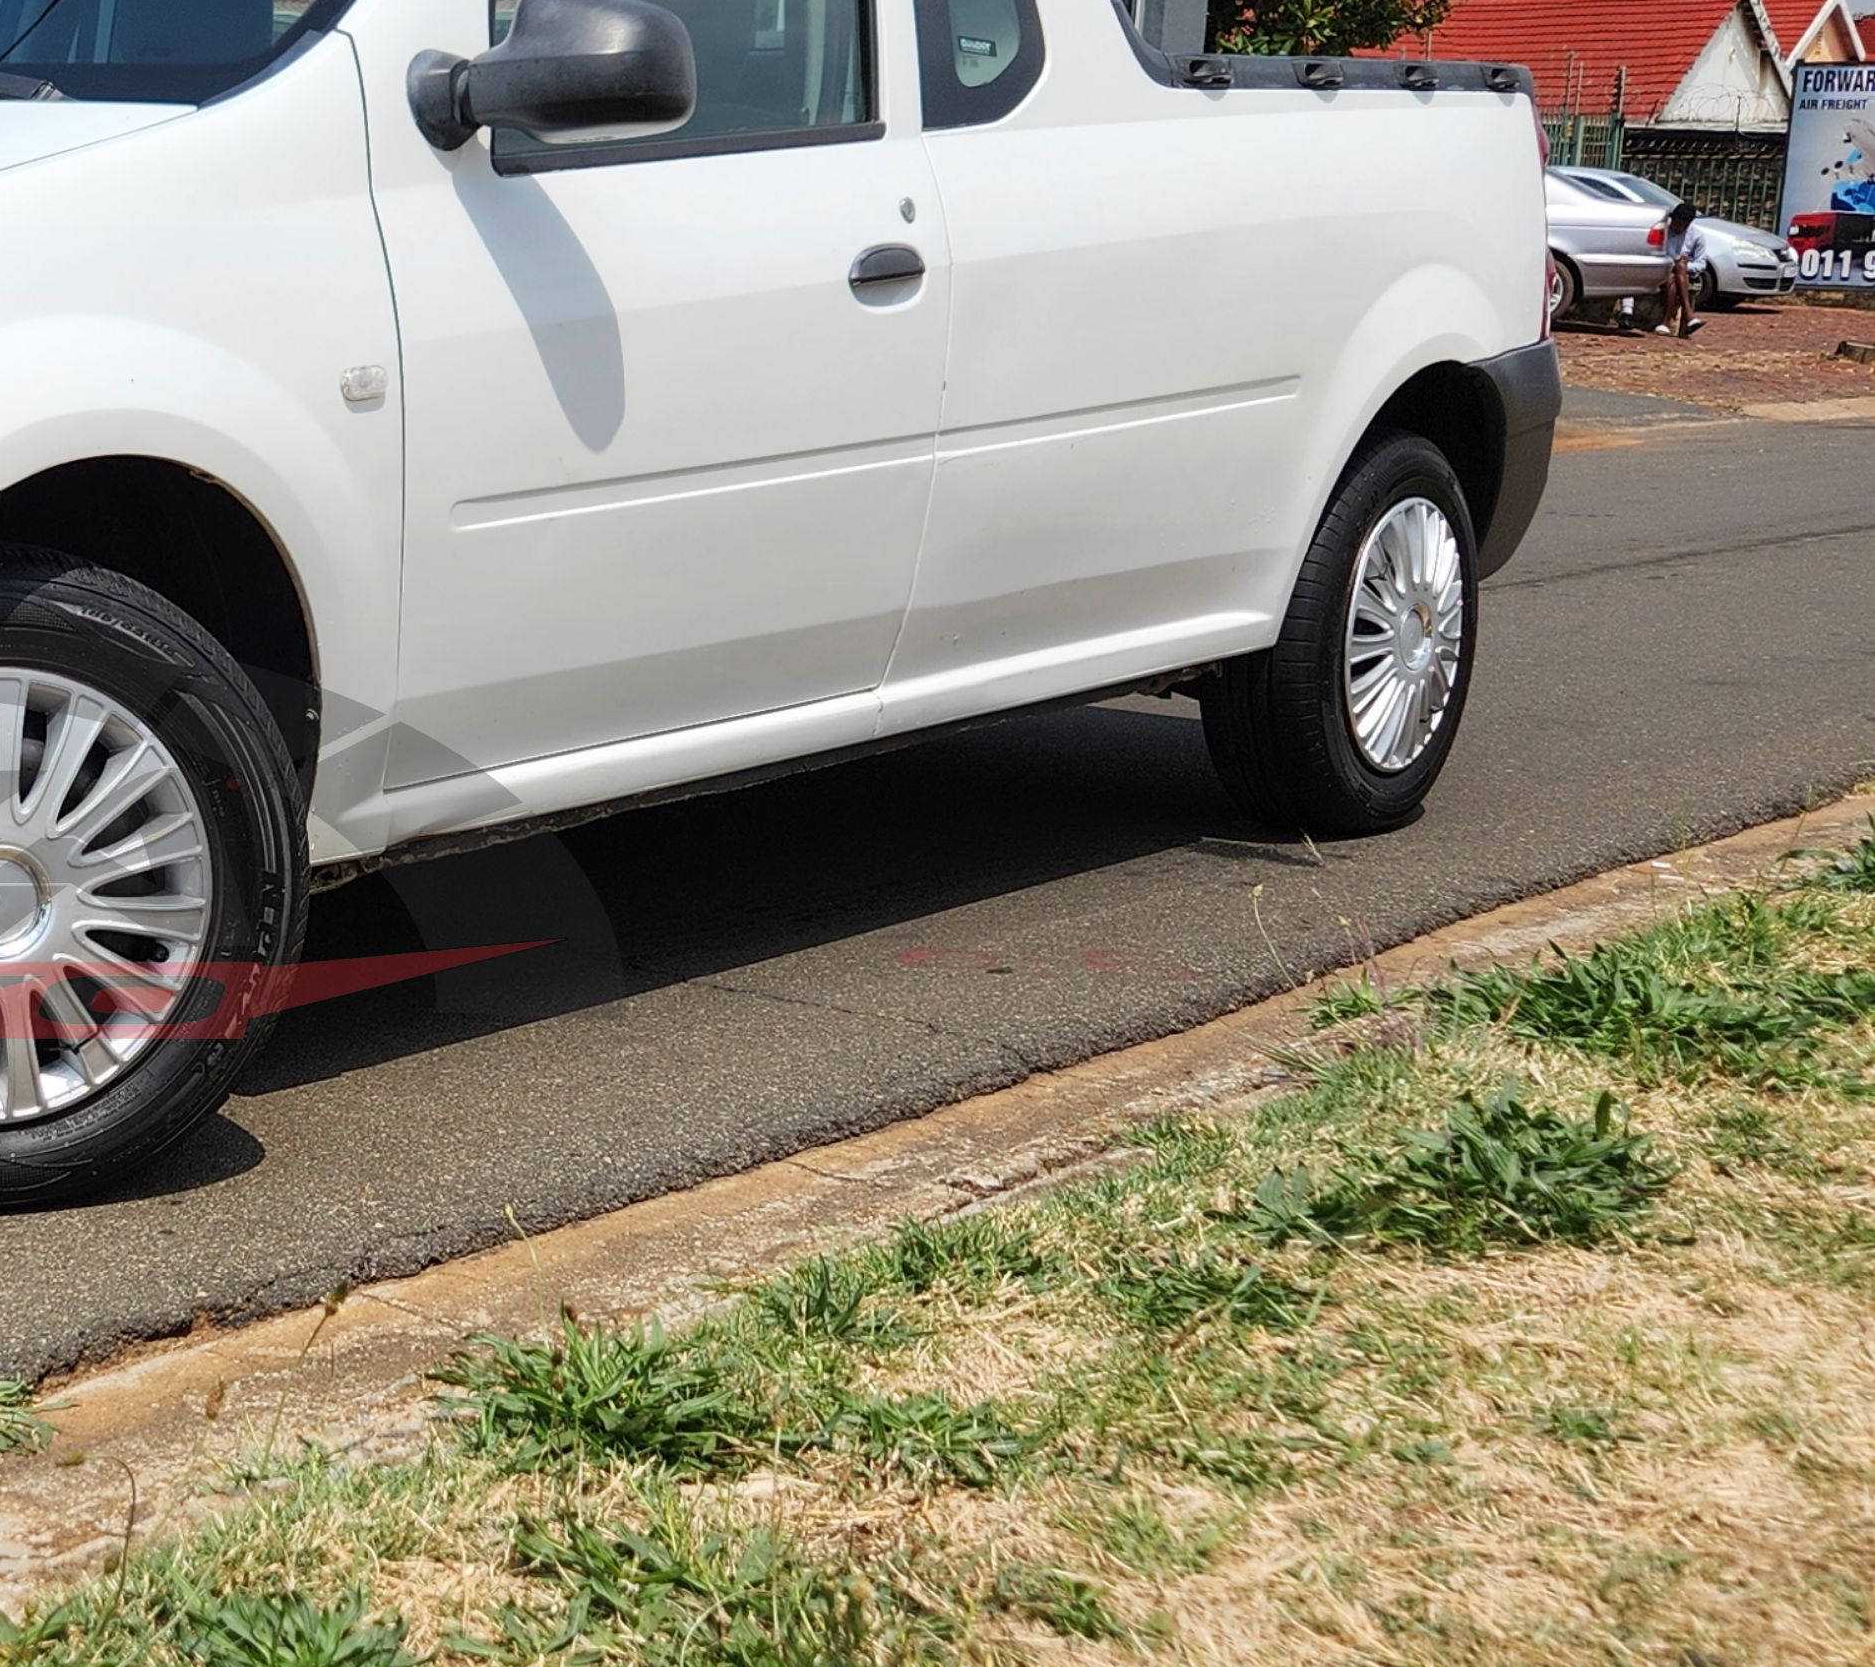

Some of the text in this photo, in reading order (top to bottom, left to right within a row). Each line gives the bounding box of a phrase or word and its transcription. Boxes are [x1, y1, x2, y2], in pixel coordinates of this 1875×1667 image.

[1799, 98, 1868, 110] AIR FREIGHT
[1801, 249, 1852, 277] 011
